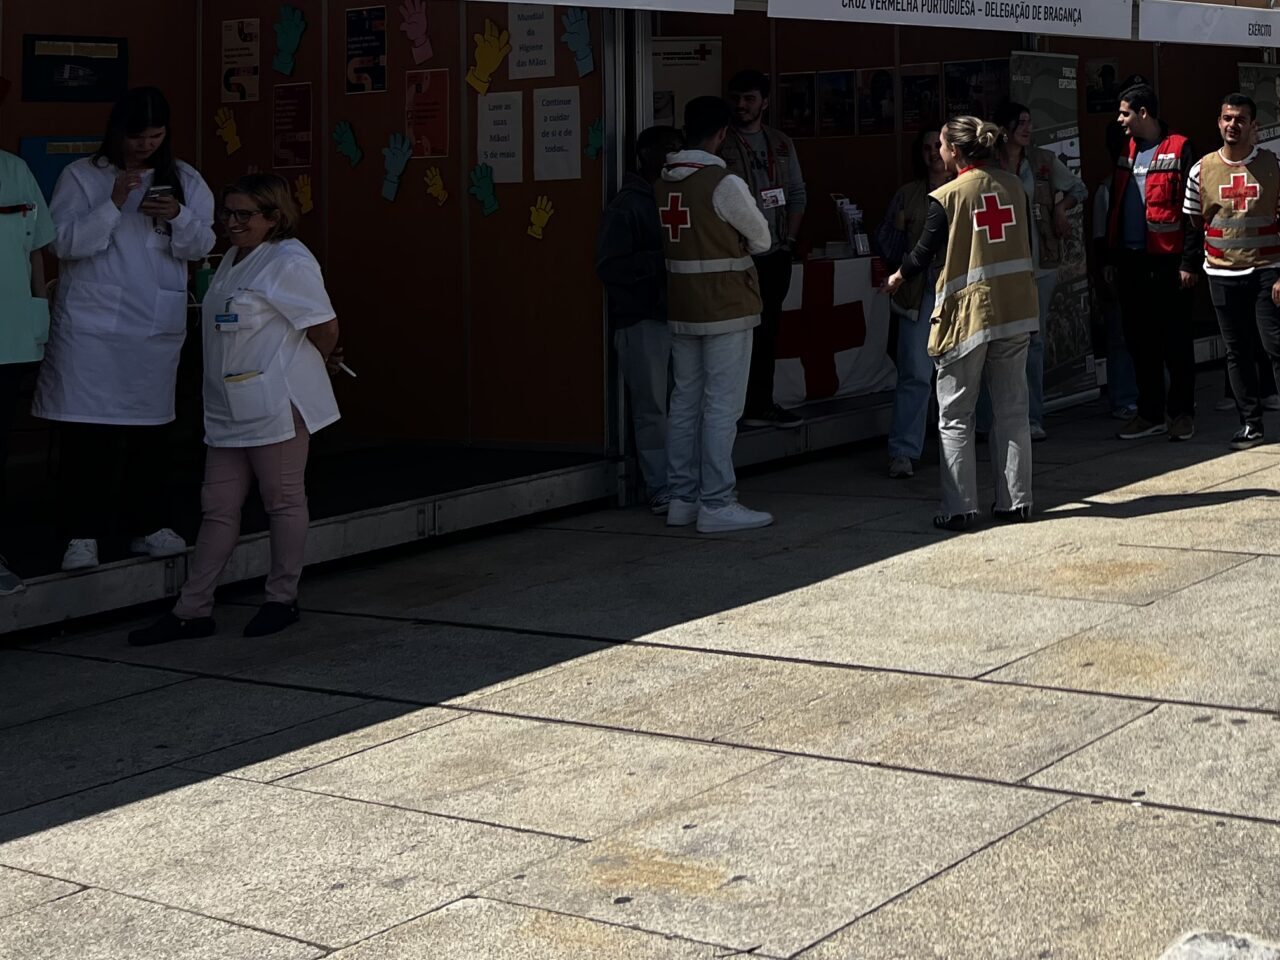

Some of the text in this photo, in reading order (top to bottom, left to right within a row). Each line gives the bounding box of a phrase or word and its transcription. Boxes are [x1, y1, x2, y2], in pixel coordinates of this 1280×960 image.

[984, 1, 1030, 23] DELEGAÇÃO
[1032, 5, 1042, 20] DE
[1043, 5, 1082, 27] BRAGANÇA
[1248, 20, 1272, 37] EXÉRCITO
